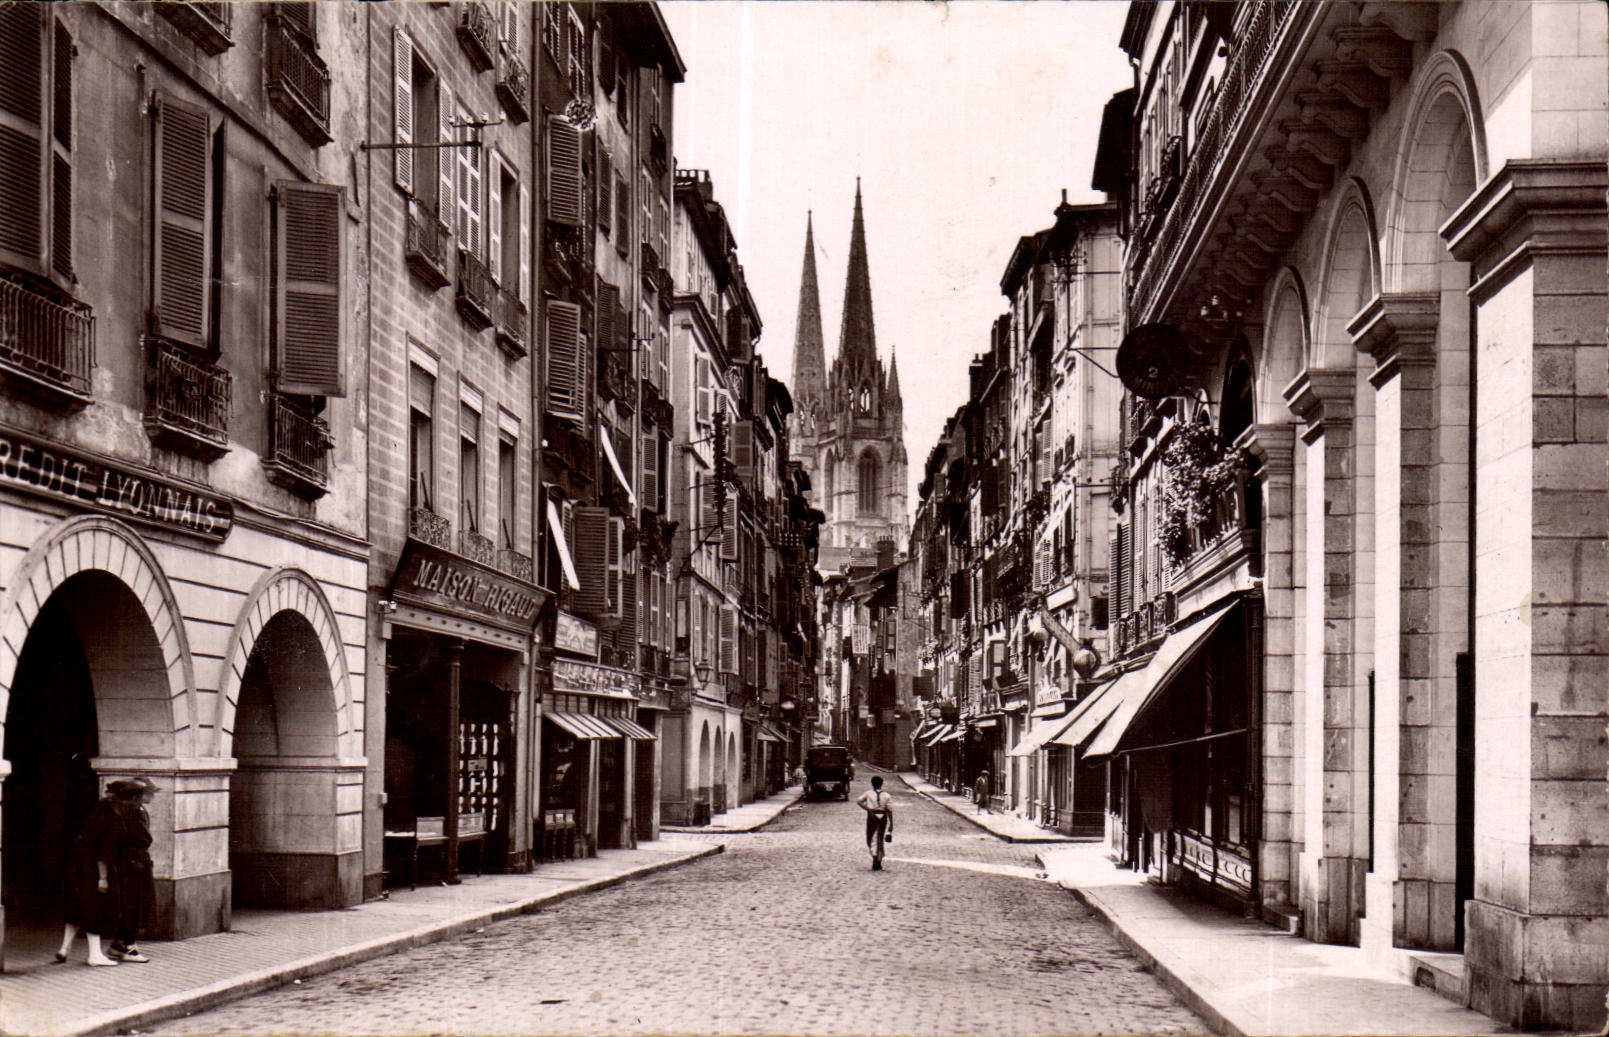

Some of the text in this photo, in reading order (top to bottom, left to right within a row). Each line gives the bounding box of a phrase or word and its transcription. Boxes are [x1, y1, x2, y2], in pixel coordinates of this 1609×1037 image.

[96, 470, 217, 533] LYONNAIS
[413, 559, 536, 619] MAISON RIGAUD
